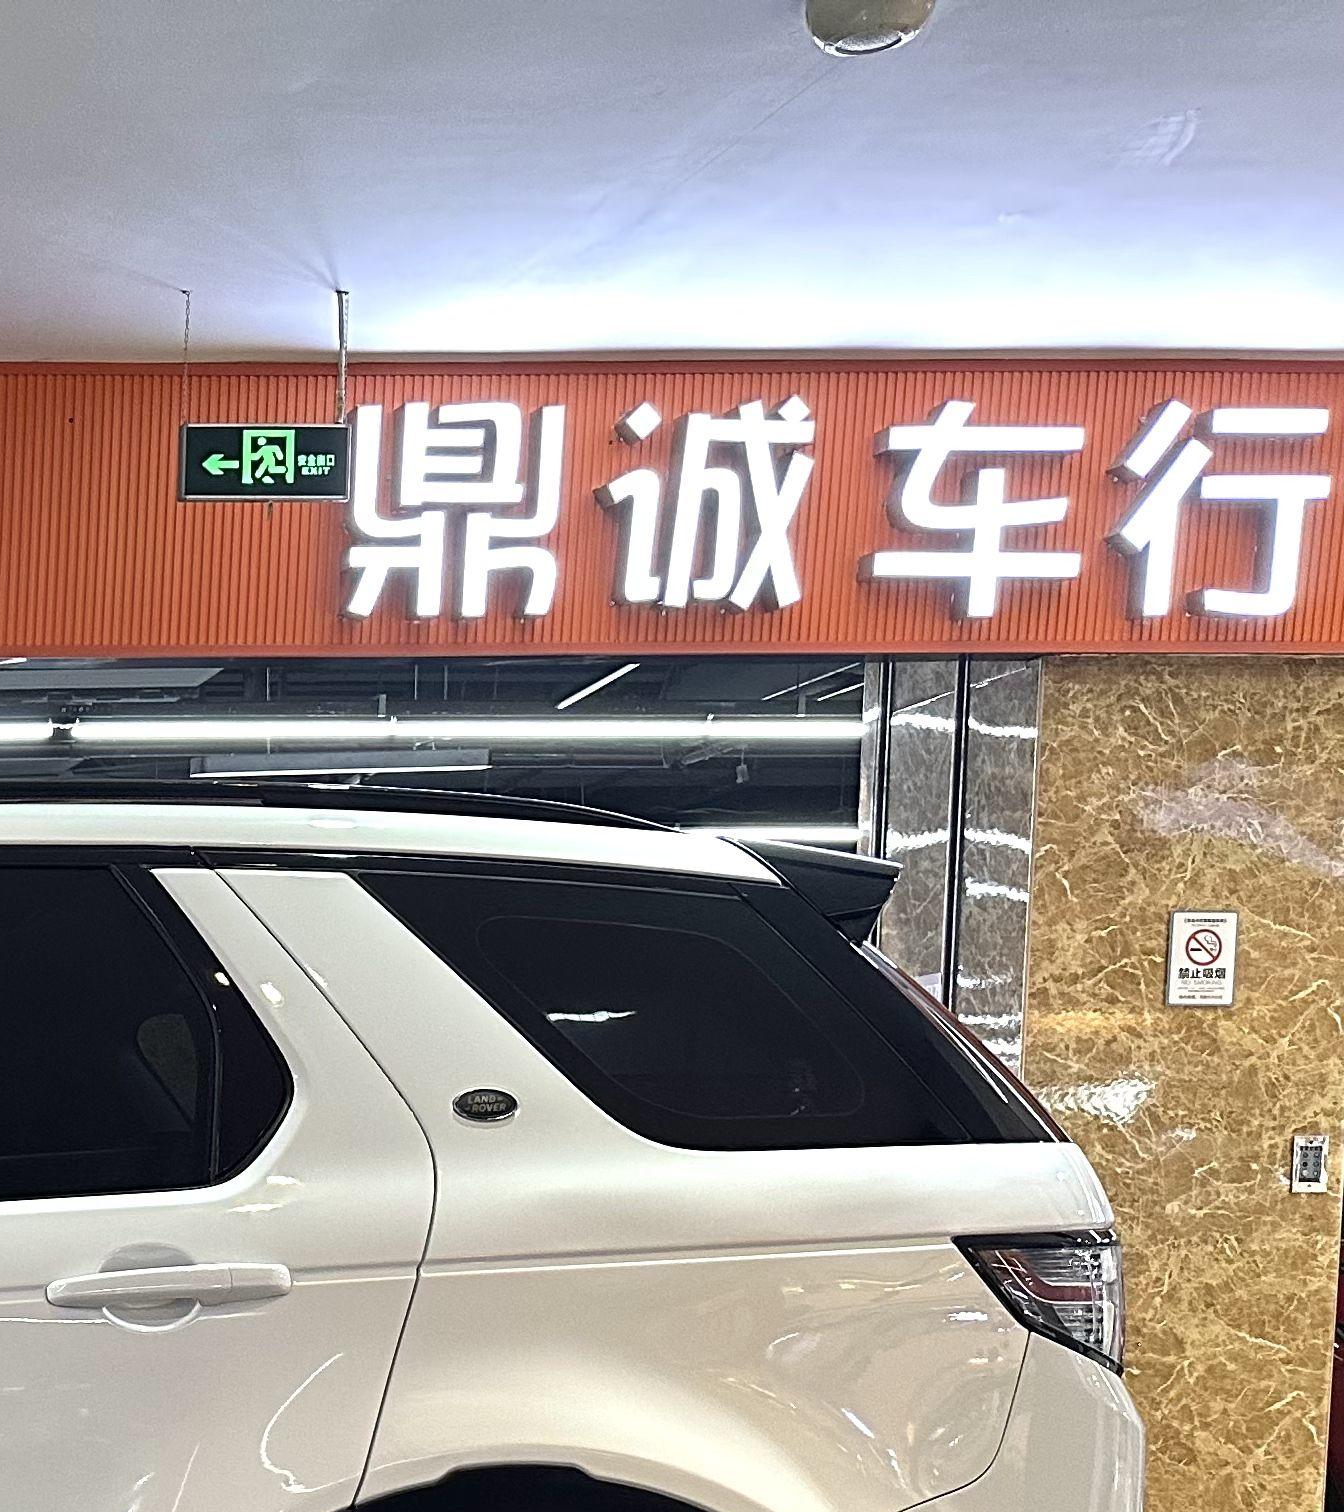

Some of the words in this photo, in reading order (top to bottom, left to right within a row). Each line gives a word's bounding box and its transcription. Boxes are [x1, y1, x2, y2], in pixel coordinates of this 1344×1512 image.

[302, 467, 331, 475] EXIT
[345, 394, 1332, 619] 鼎诚车行
[467, 1094, 497, 1105] LAND
[471, 1102, 507, 1113] ROVER
